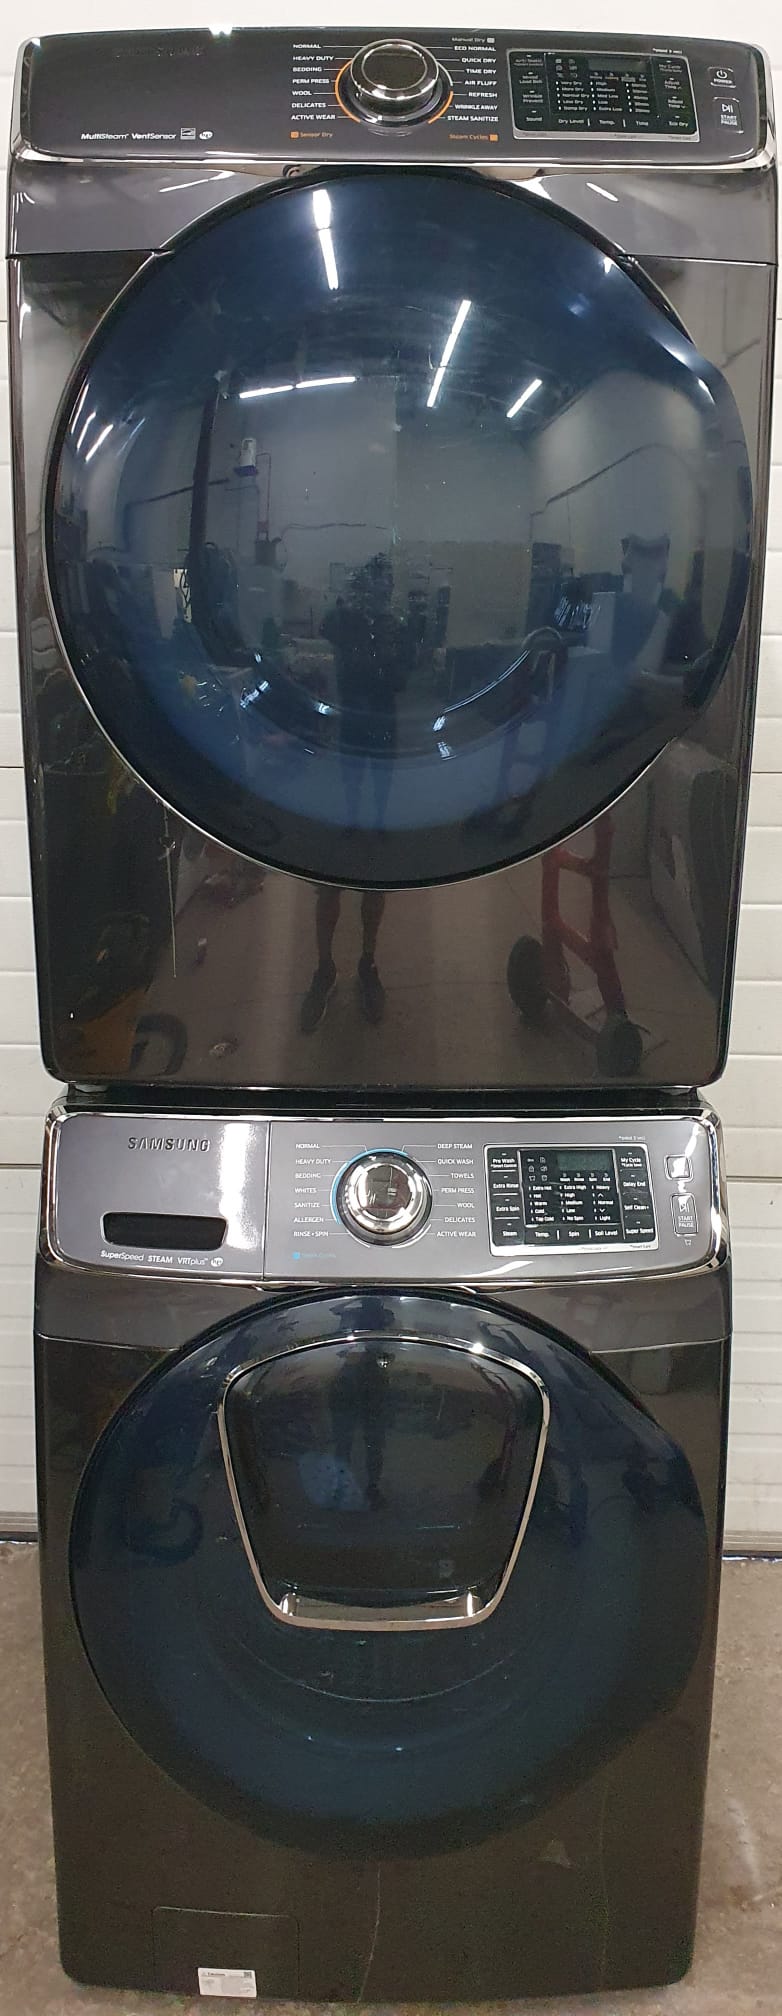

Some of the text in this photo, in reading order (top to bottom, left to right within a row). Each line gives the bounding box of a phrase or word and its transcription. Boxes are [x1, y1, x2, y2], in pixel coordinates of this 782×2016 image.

[128, 1136, 211, 1152] SAMSUNG
[100, 1250, 144, 1262] SuperSpeed
[147, 1255, 173, 1263] STEAM
